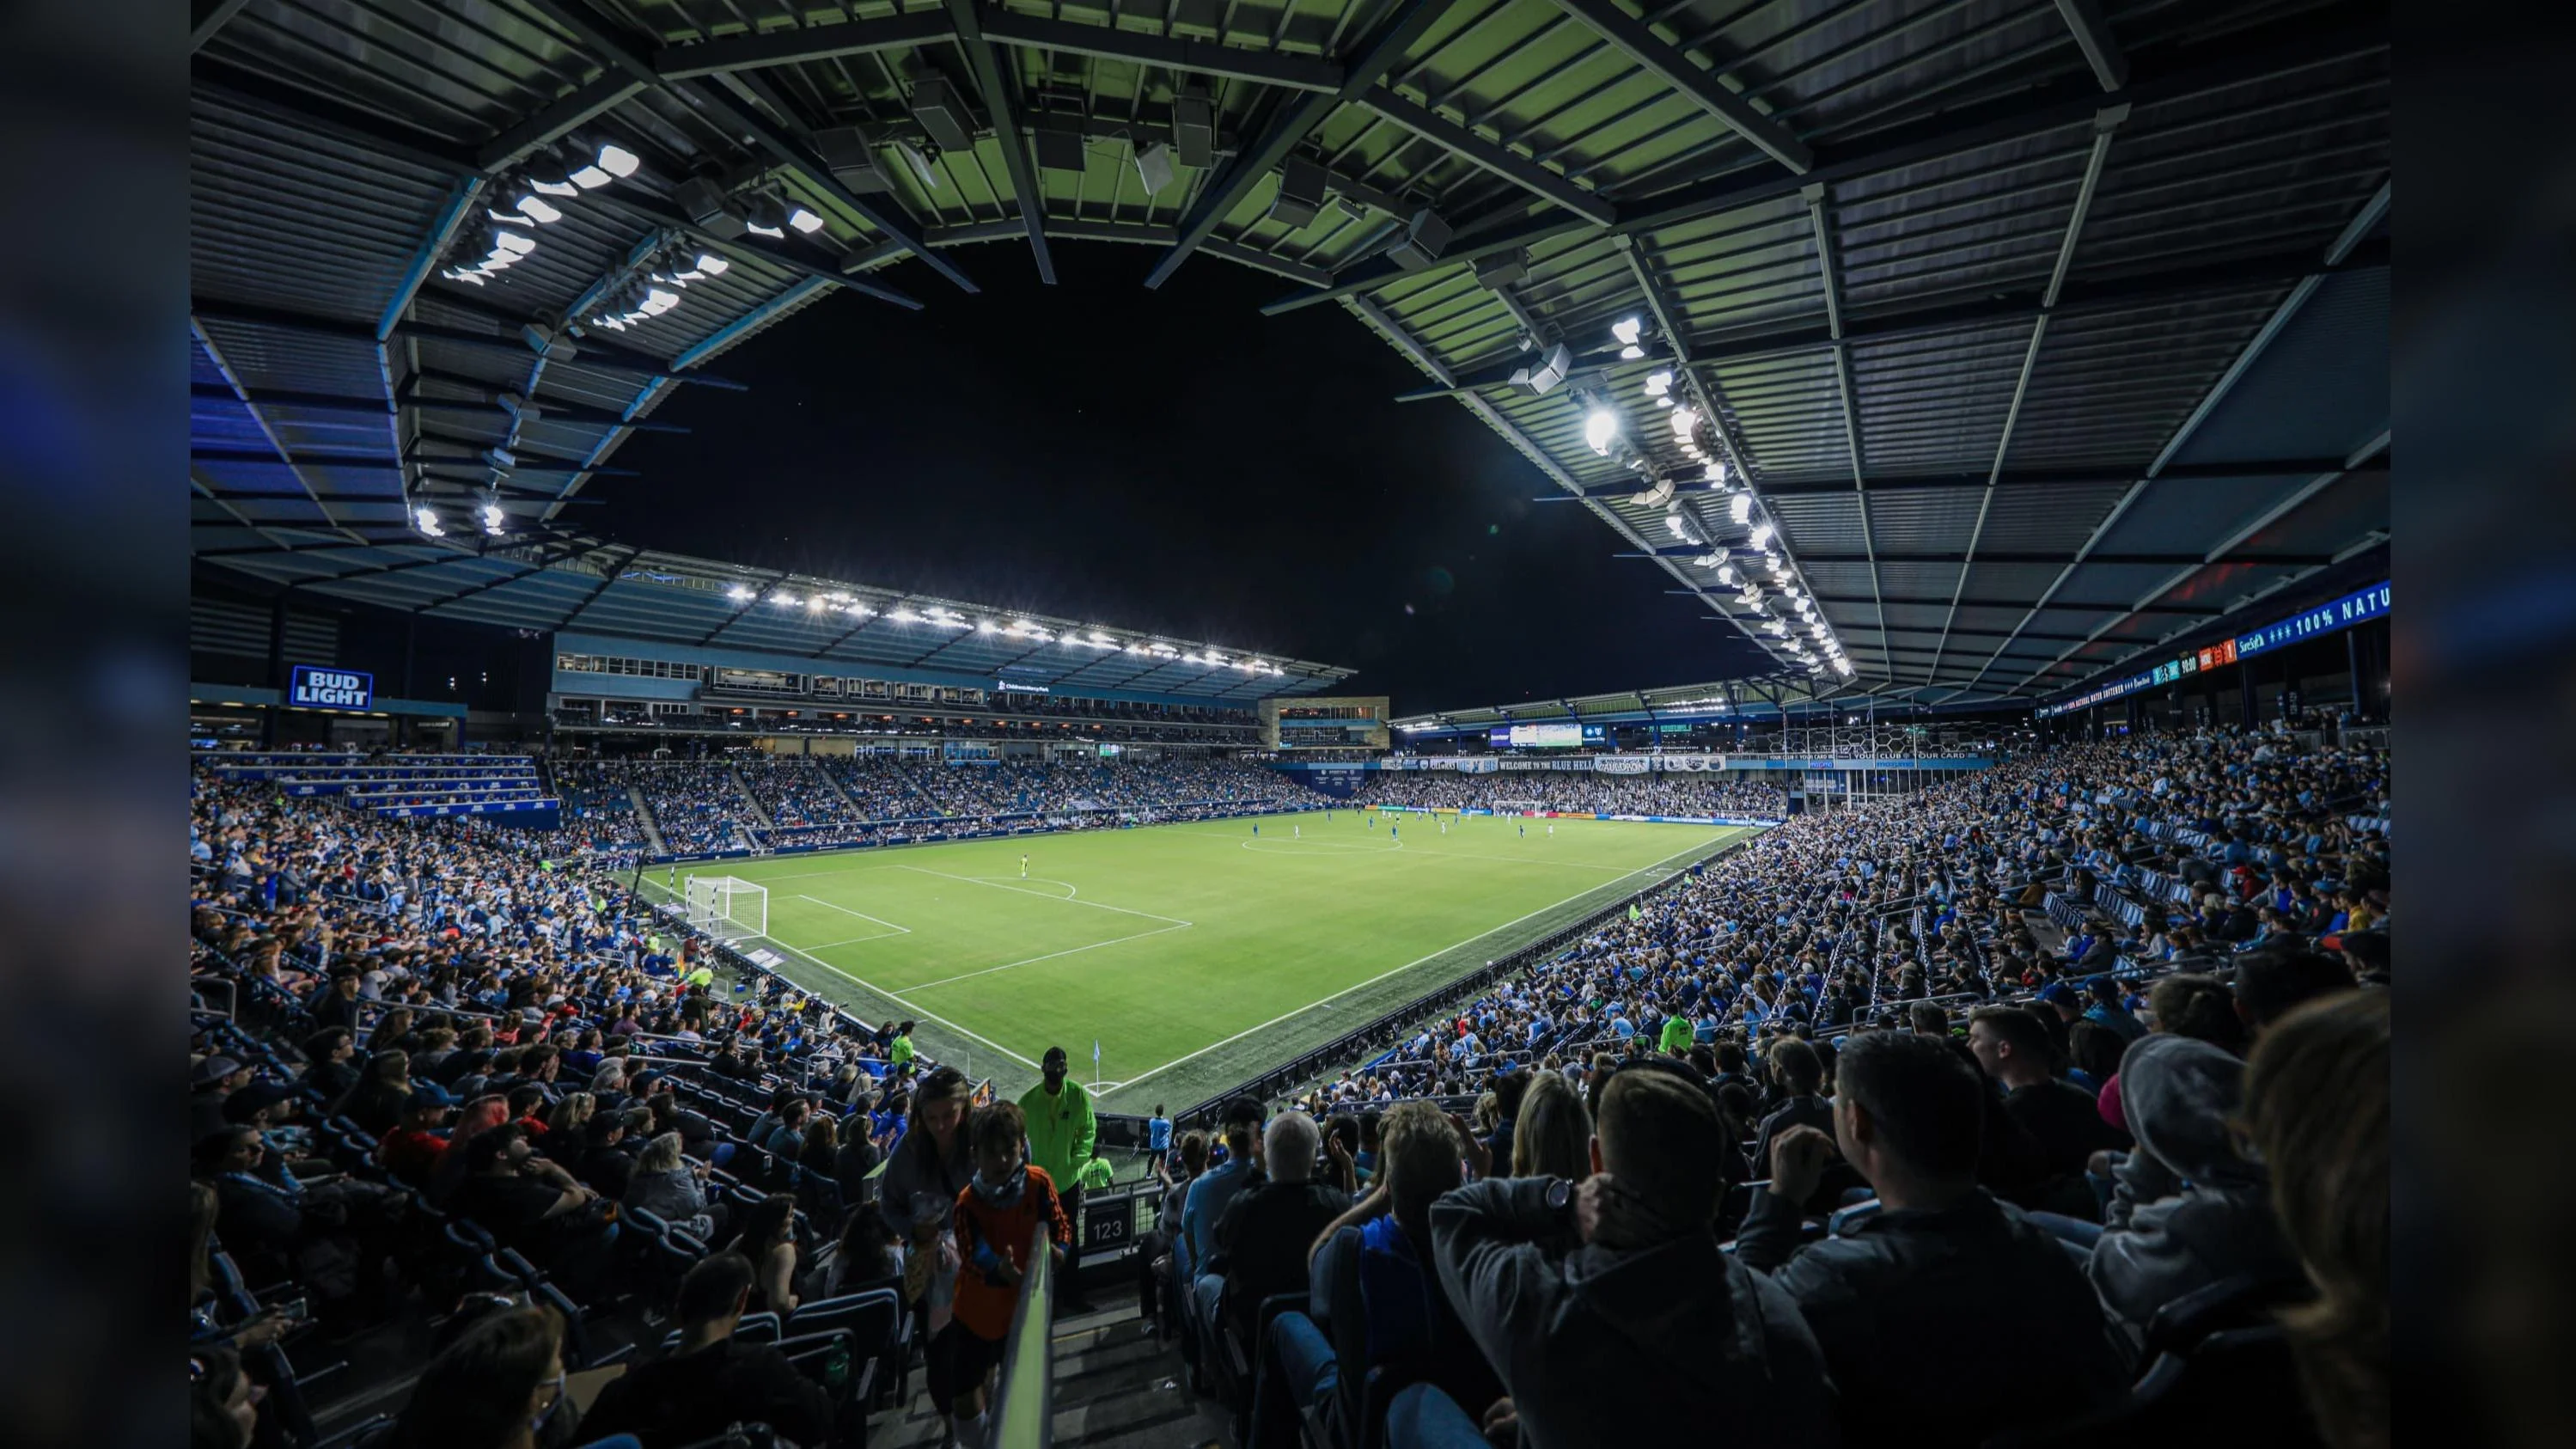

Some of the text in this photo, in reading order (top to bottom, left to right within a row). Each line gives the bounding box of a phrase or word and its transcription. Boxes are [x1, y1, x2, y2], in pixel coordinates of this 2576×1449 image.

[2297, 609, 2333, 635] 100%
[2342, 588, 2390, 620] NATU
[309, 671, 359, 690] BUD
[296, 686, 367, 706] LIGHT
[1499, 761, 1531, 770] WELCOME
[1541, 761, 1551, 770] THE
[1552, 760, 1572, 770] BLUE
[1093, 1220, 1123, 1241] 123
